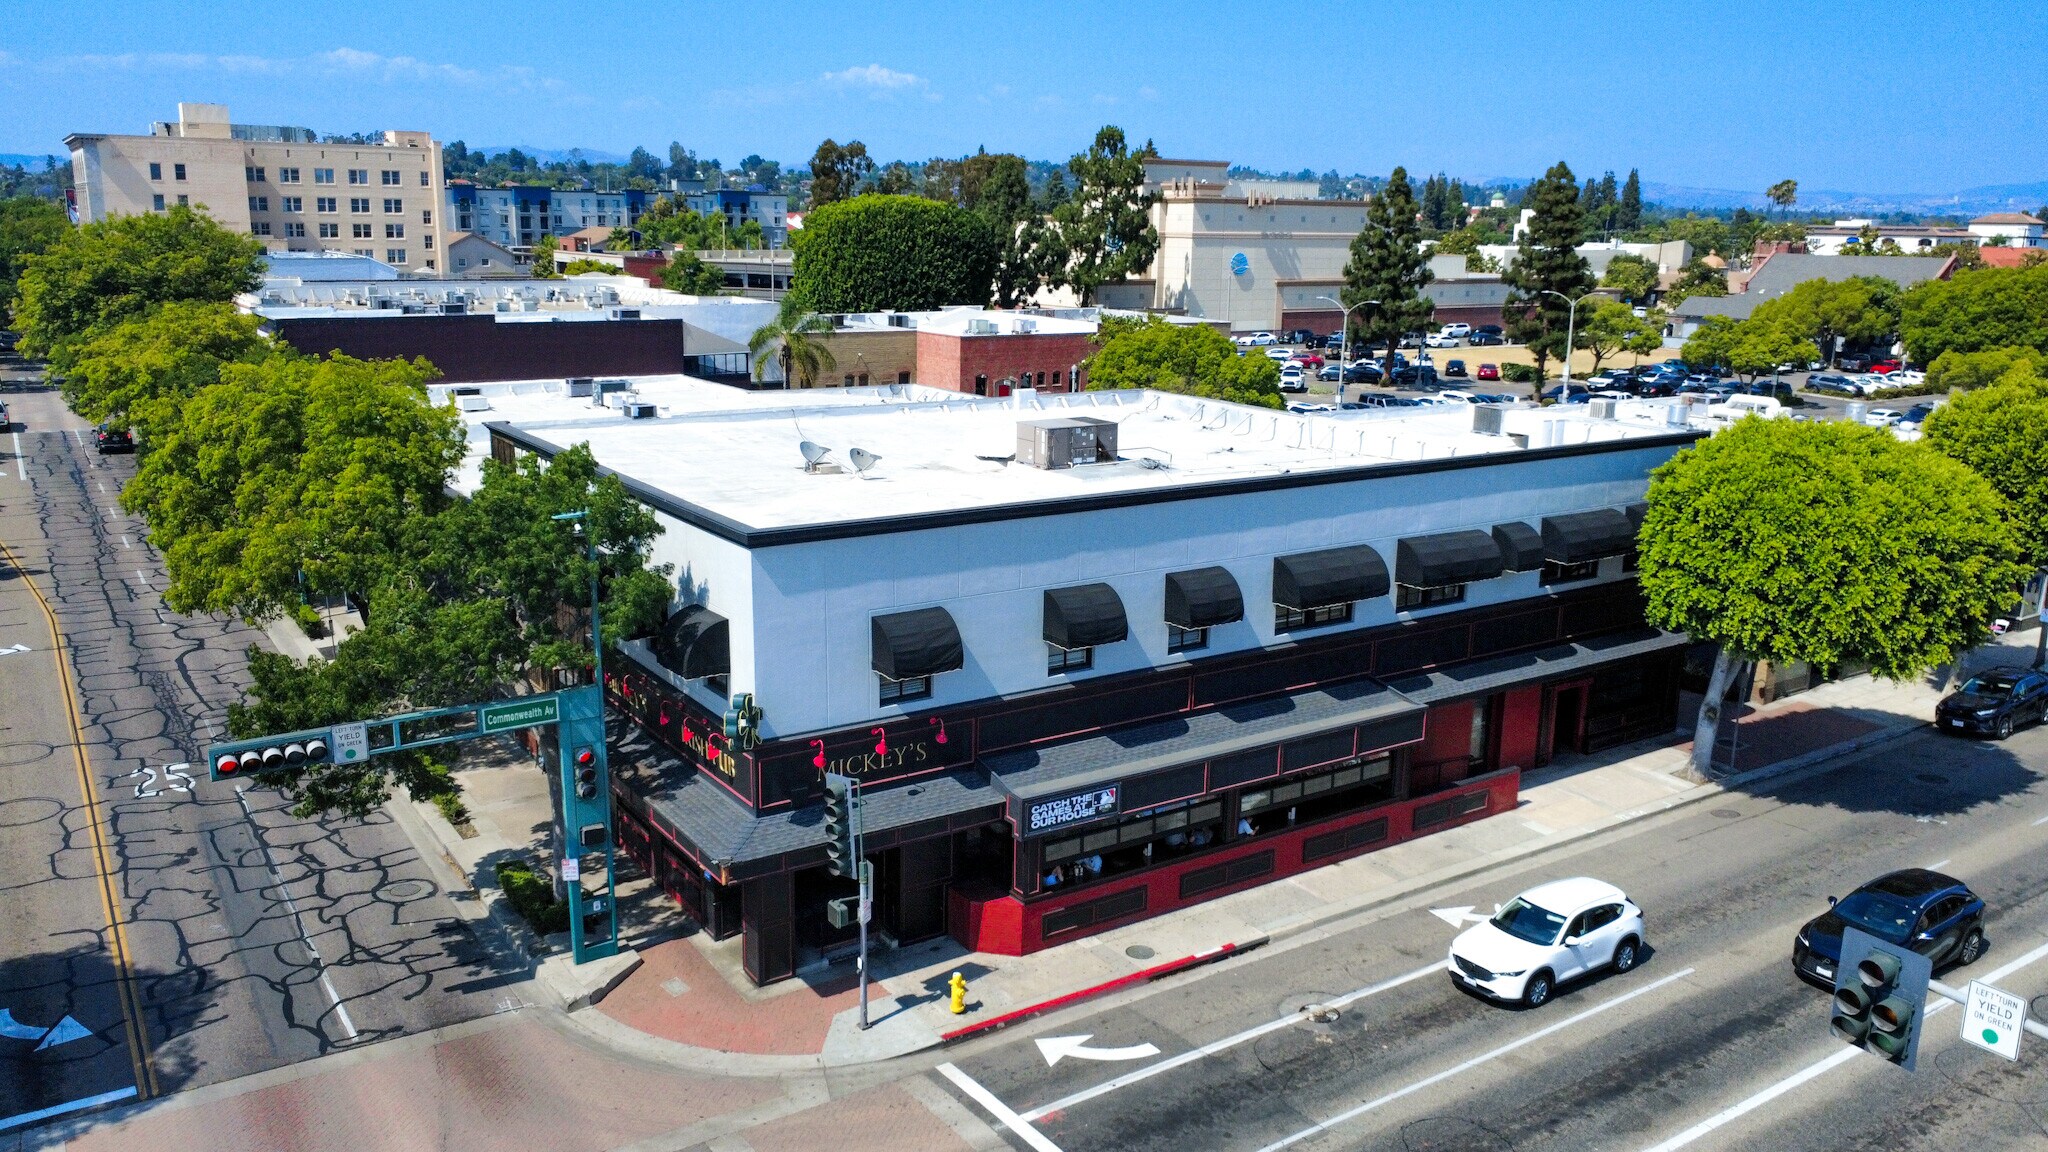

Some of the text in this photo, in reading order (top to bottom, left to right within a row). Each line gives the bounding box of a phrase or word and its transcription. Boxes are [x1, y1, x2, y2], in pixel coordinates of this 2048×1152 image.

[487, 706, 555, 724] Commonwealth Av
[339, 732, 361, 740] YIELD
[682, 724, 736, 777] IISH UB
[129, 763, 196, 798] 25
[1031, 802, 1087, 821] GAMES AT
[1032, 794, 1093, 814] CATCH THE
[1031, 806, 1096, 829] OUR HOUSE
[1976, 987, 2018, 1010] LEFT TURN
[1978, 999, 2013, 1019] YIELD
[1974, 1011, 2012, 1031] ON GREEN
